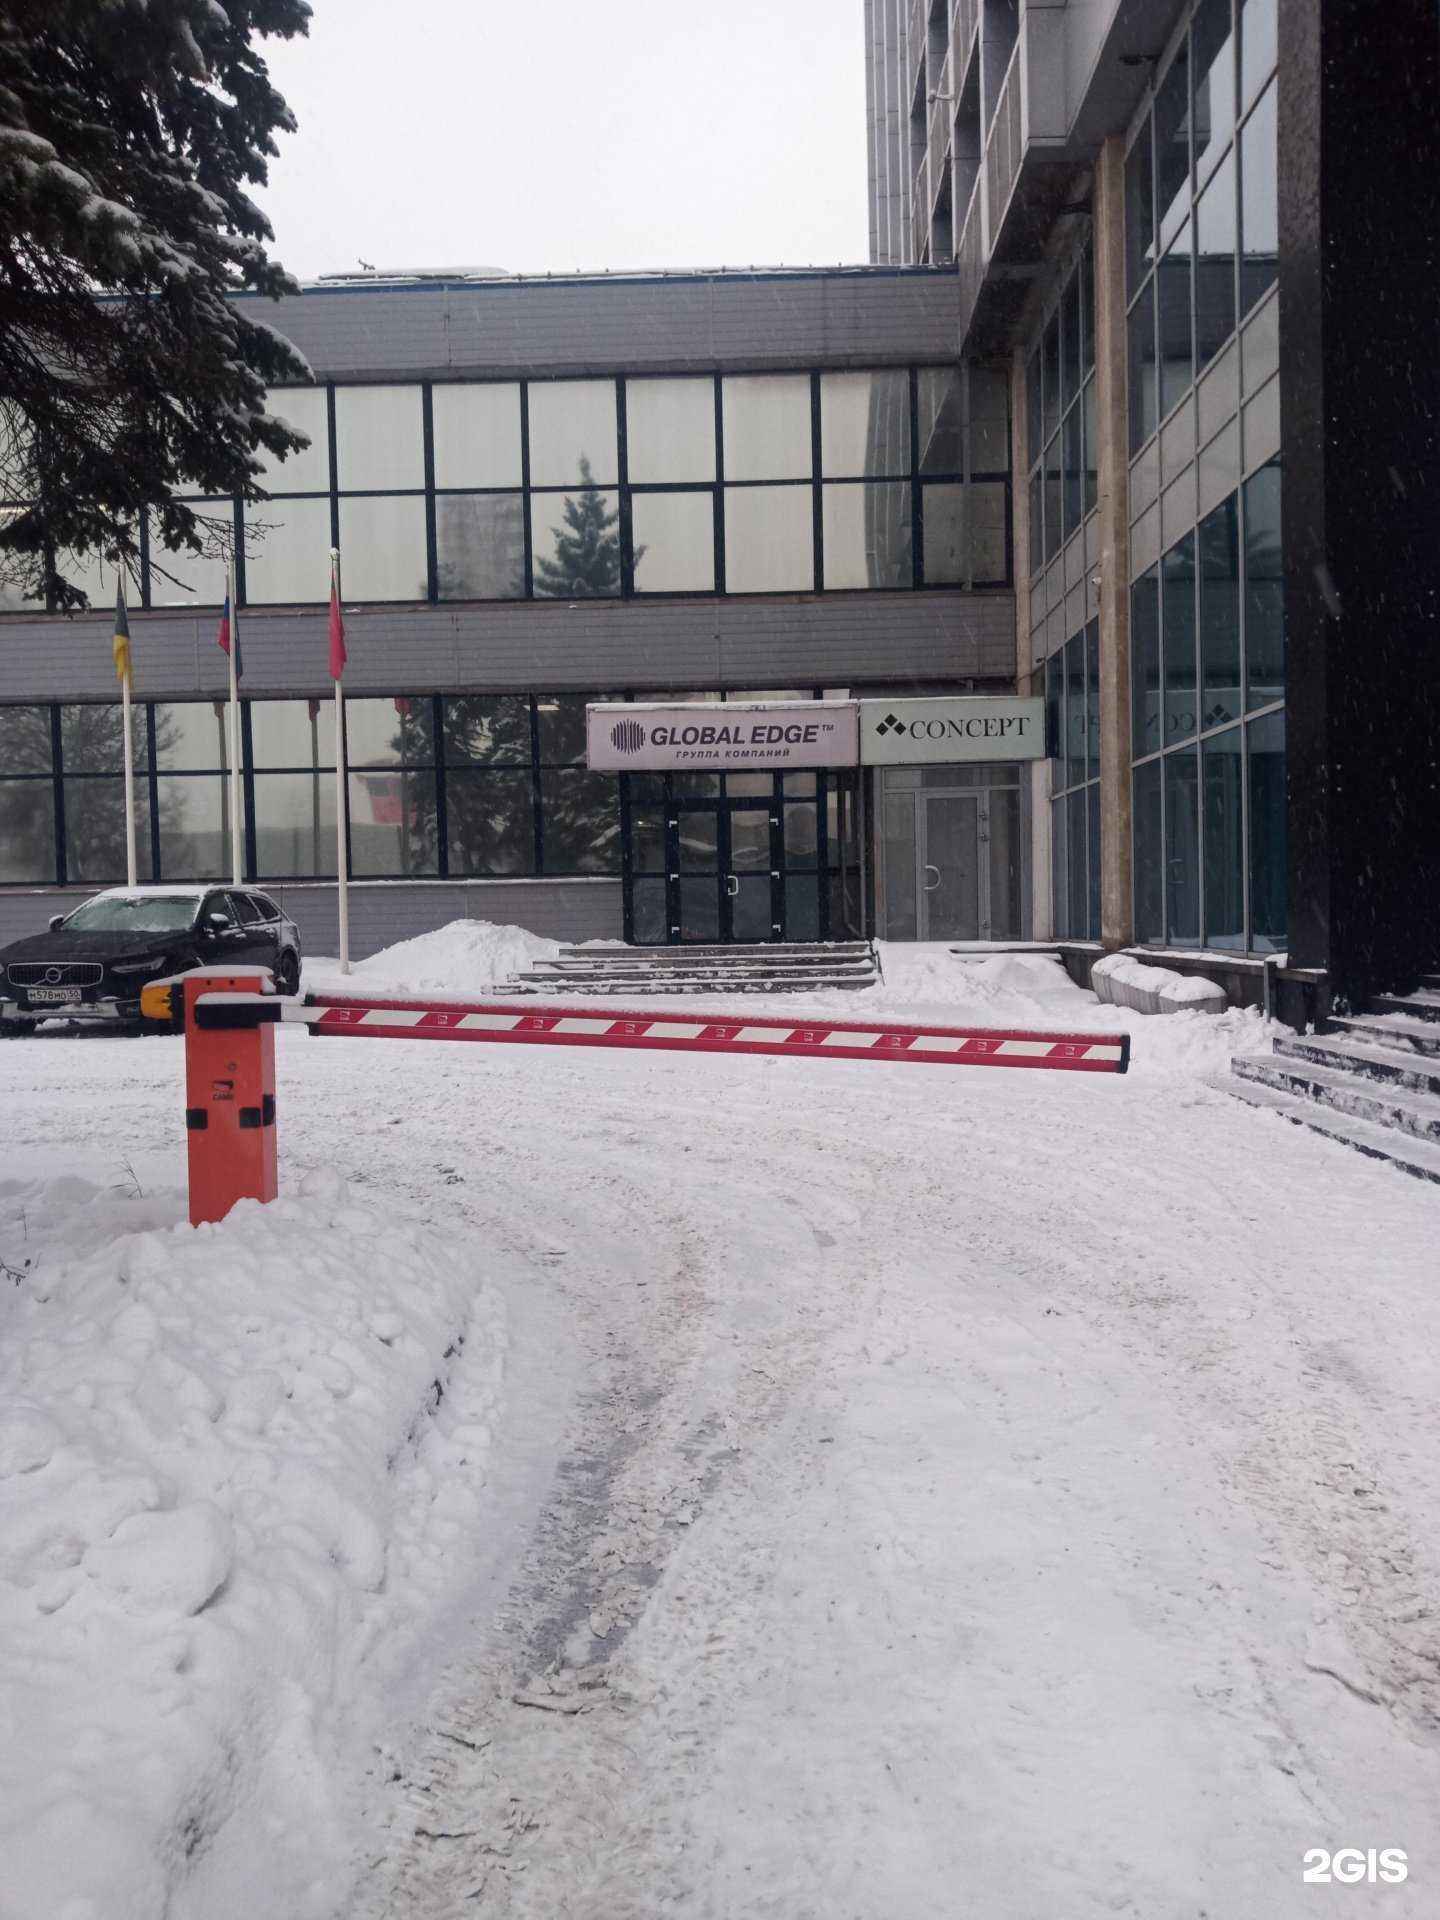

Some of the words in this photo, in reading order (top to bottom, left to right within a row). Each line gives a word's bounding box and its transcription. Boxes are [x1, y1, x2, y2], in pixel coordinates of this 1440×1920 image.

[650, 726, 746, 746] GLOBAL
[750, 724, 819, 744] EDGE
[909, 716, 1030, 740] CONCEPT
[676, 750, 720, 759] ГРУППА
[725, 748, 791, 759] КОМПАНИЙ
